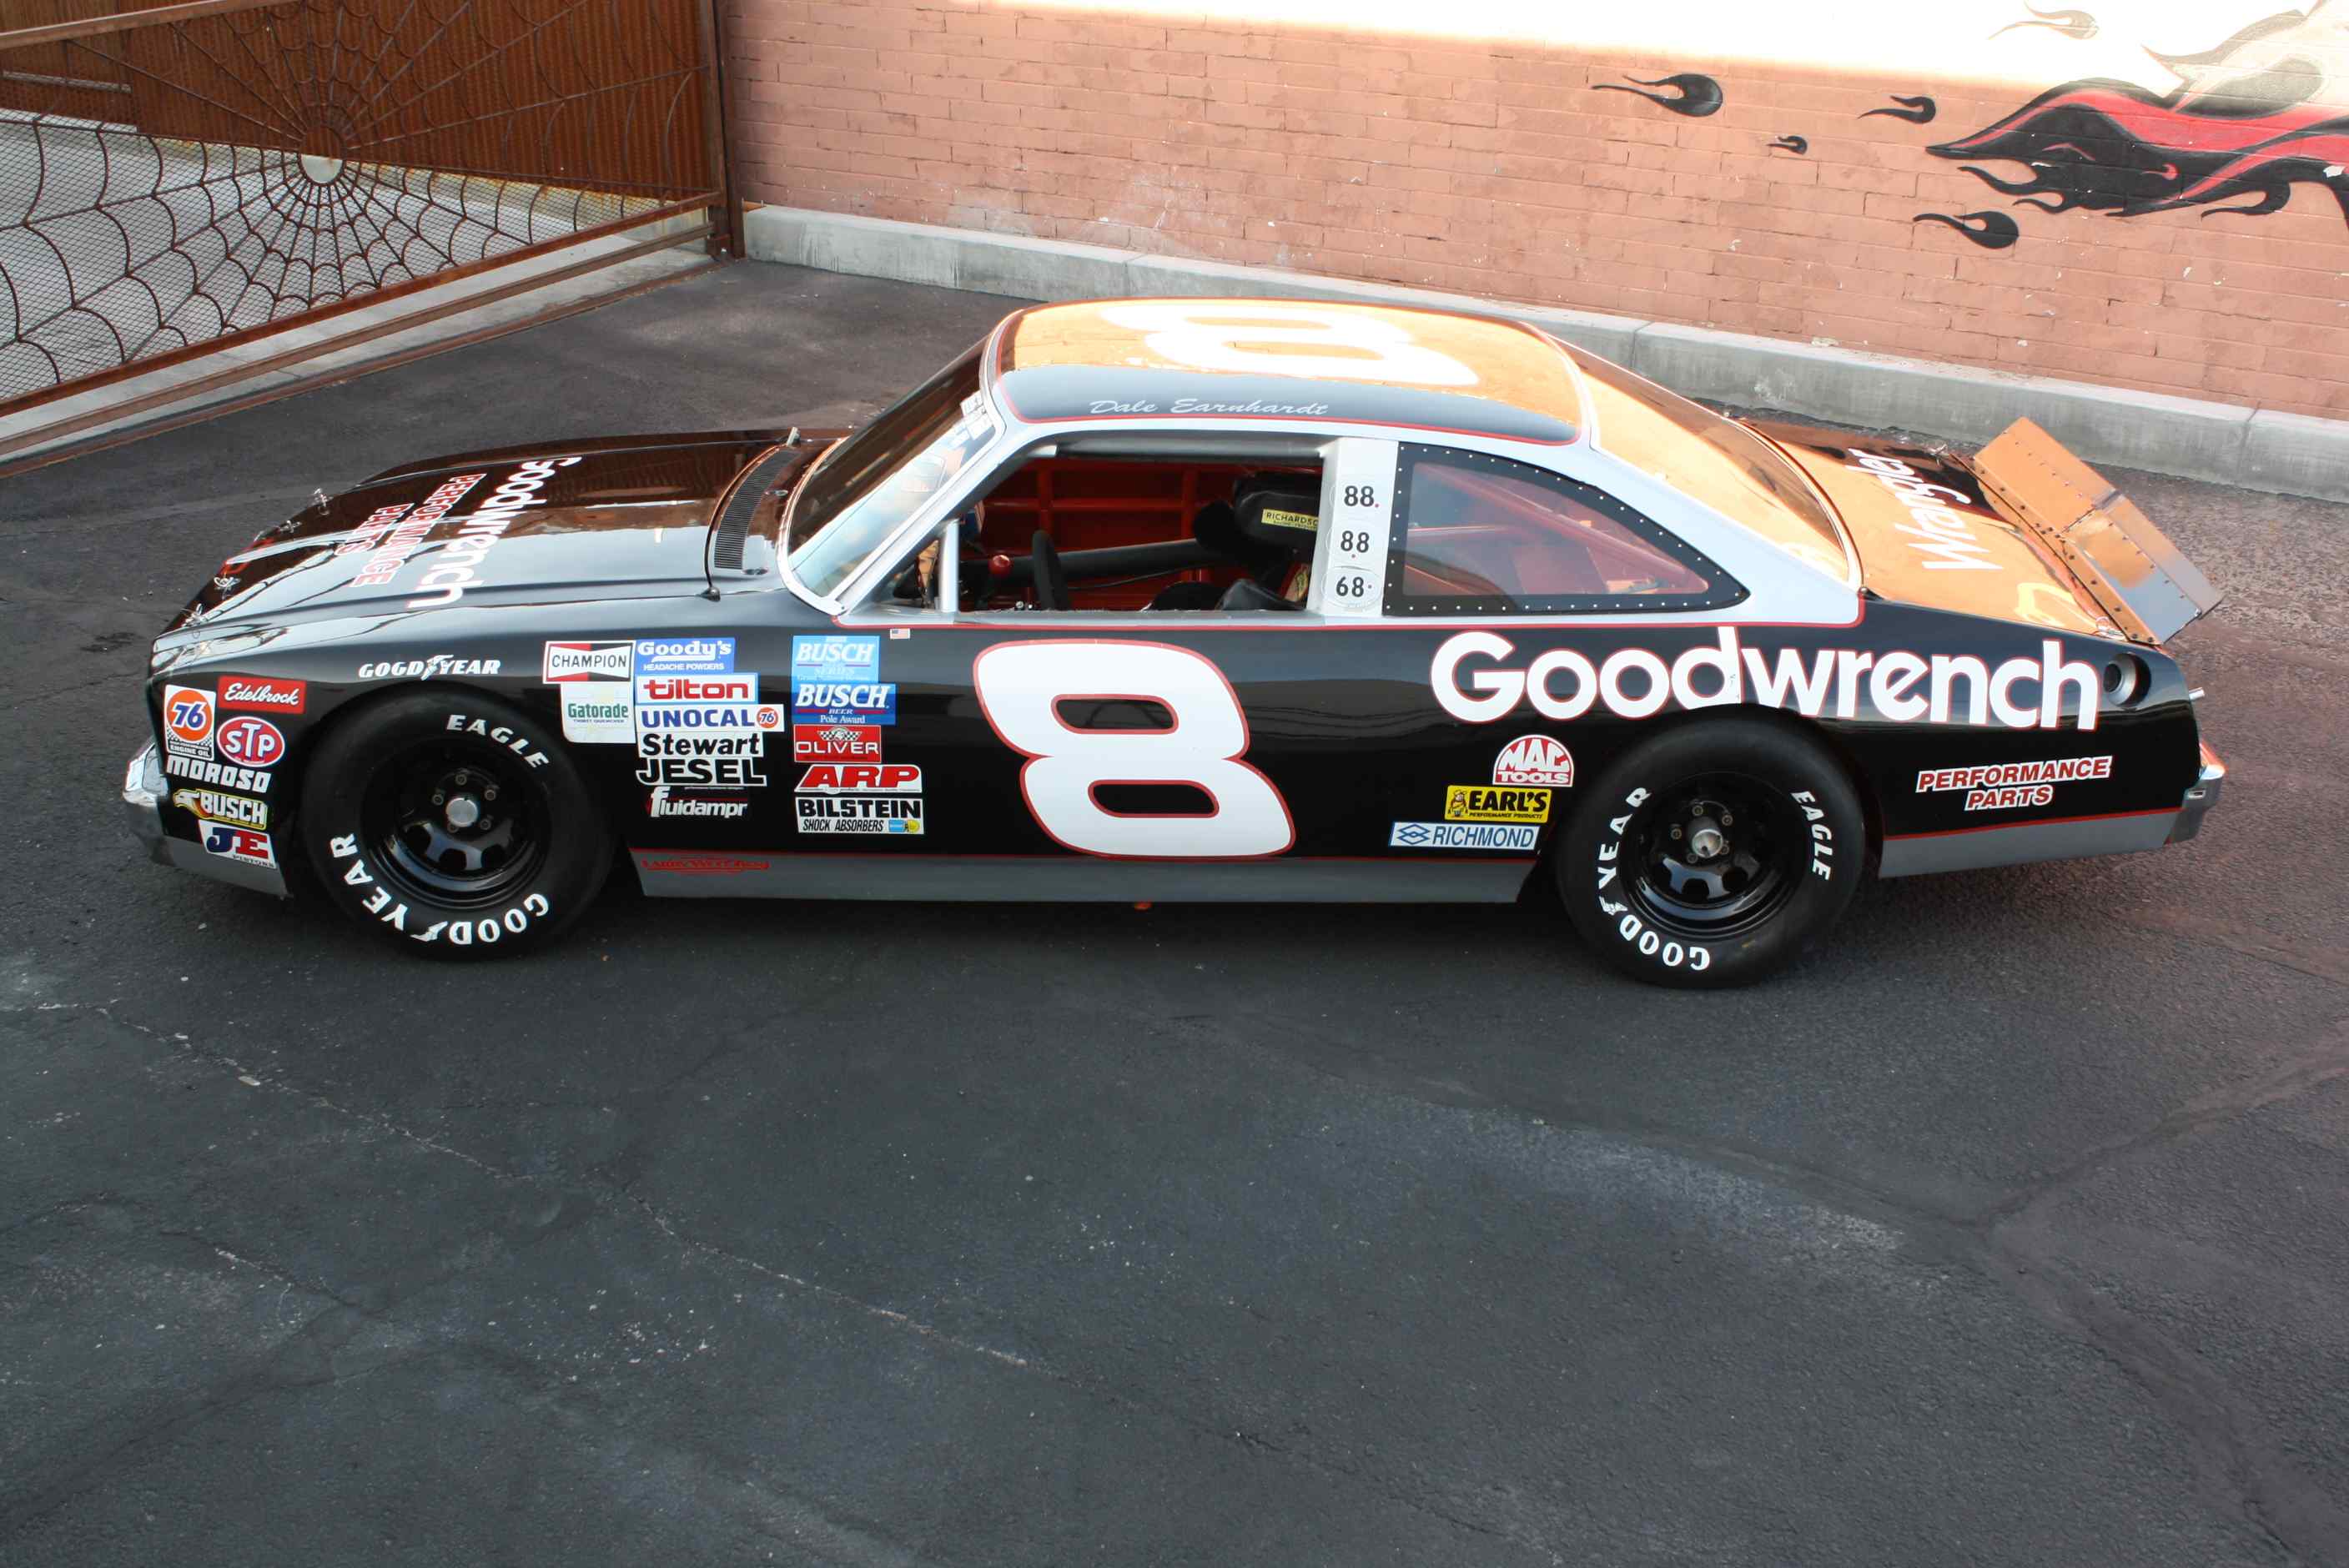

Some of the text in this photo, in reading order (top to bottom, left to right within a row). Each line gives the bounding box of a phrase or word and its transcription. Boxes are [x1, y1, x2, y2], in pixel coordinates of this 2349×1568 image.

[1100, 302, 1479, 385] 8
[1089, 398, 1329, 415] Dale Earnhardt
[1344, 485, 1375, 507] 88
[1266, 511, 1319, 525] RICHARDSO
[1845, 448, 2003, 570] Wrangler
[334, 502, 415, 556] PARTS
[350, 473, 487, 588] PERFORMANCE
[408, 456, 582, 610] Goodwrench
[1340, 530, 1370, 553] 88
[1335, 575, 1365, 597] 68
[551, 654, 626, 668] CHAMPION
[637, 640, 732, 661] Goody's
[795, 642, 875, 662] BUSCH
[643, 679, 749, 700] tilton
[1431, 626, 2100, 731] Goodwrench
[224, 681, 301, 706] Edelbrock
[795, 683, 891, 709] BUSCH
[171, 701, 208, 731] 76
[567, 703, 629, 718] Gatorade
[641, 709, 776, 728] UNOCAL 76
[820, 715, 866, 723] Pole Award
[224, 721, 276, 759] STP
[445, 714, 550, 768] EAGLE
[641, 733, 760, 756] Stewart
[796, 741, 879, 754] OLIVER
[973, 638, 1296, 860] 8
[1498, 738, 1571, 772] MAC
[167, 755, 272, 793] MOROSO
[636, 758, 767, 785] JESEL
[800, 766, 920, 788] ARP
[1497, 771, 1570, 784] TOOLS
[1916, 756, 2113, 792] PERFORMANCE
[200, 792, 268, 825] BUSCH
[650, 787, 748, 818] fluidampr
[797, 799, 922, 818] BILSTEIN
[1468, 790, 1547, 812] EARL'S
[1964, 785, 2053, 812] PARTS
[802, 819, 884, 832] SHOCK ABSORBERS
[1432, 826, 1536, 847] RICHMOND
[1791, 791, 1833, 881] EAGLE
[206, 827, 269, 859] JE
